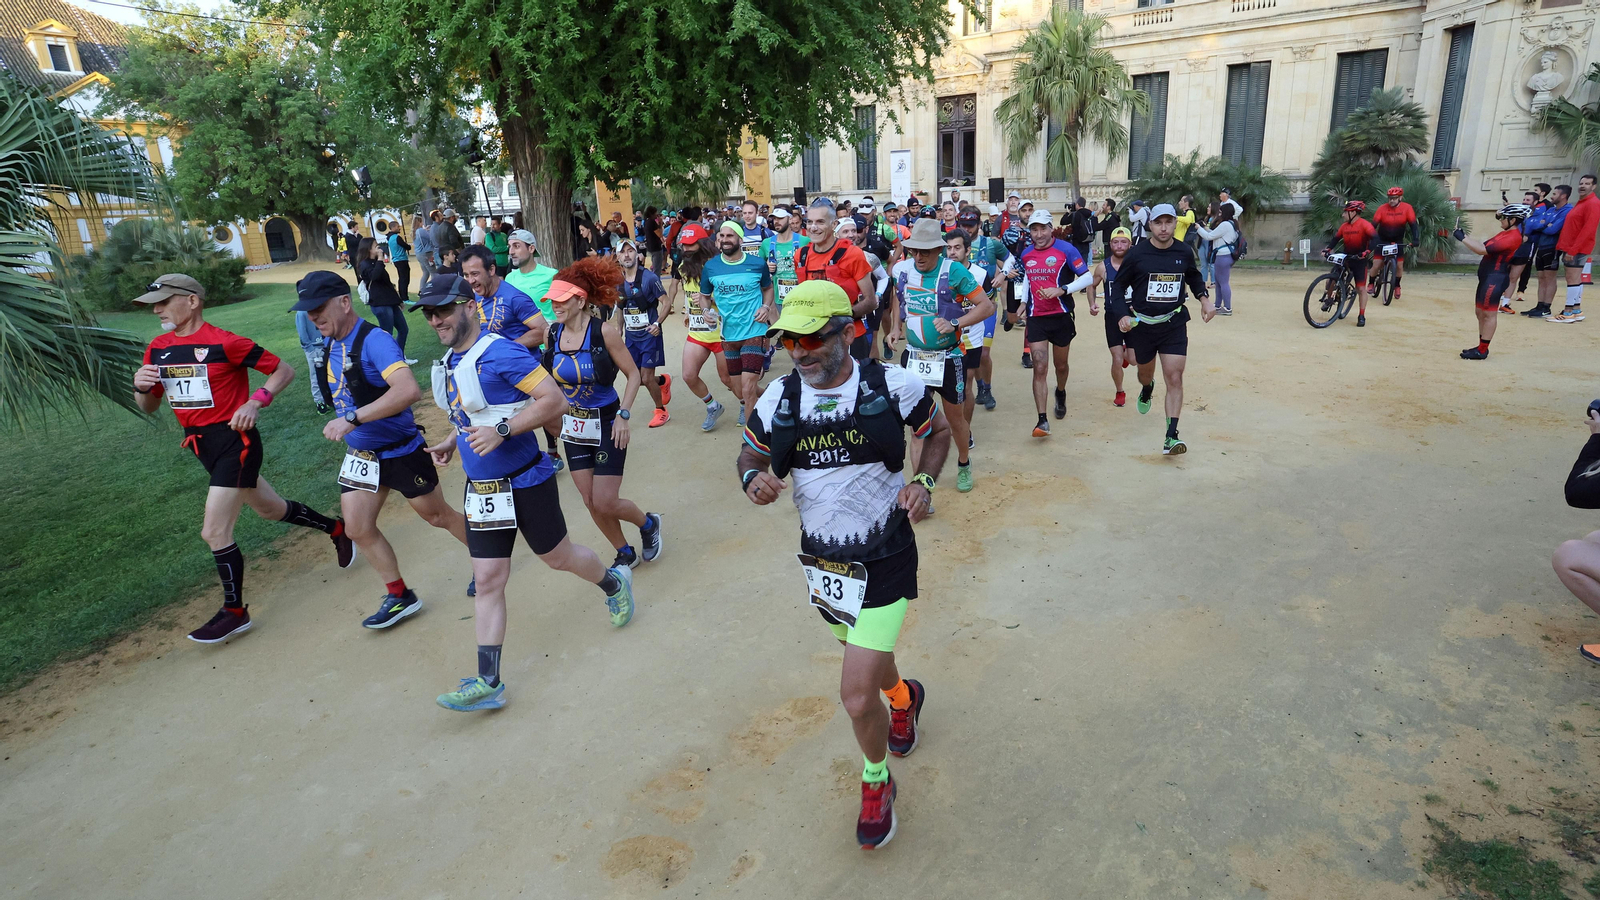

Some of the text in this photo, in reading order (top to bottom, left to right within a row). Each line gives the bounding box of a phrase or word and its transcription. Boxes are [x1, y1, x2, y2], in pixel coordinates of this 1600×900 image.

[718, 284, 746, 294] SECTA
[1156, 283, 1174, 294] 205
[792, 300, 815, 308] CORTOS
[630, 315, 641, 324] 58
[691, 316, 706, 325] 140
[168, 366, 194, 376] Sherry
[918, 361, 932, 375] 95
[175, 380, 191, 395] 17
[572, 419, 586, 434] 37
[808, 447, 851, 466] 2012
[349, 458, 369, 477] 178
[821, 575, 844, 601] 83
